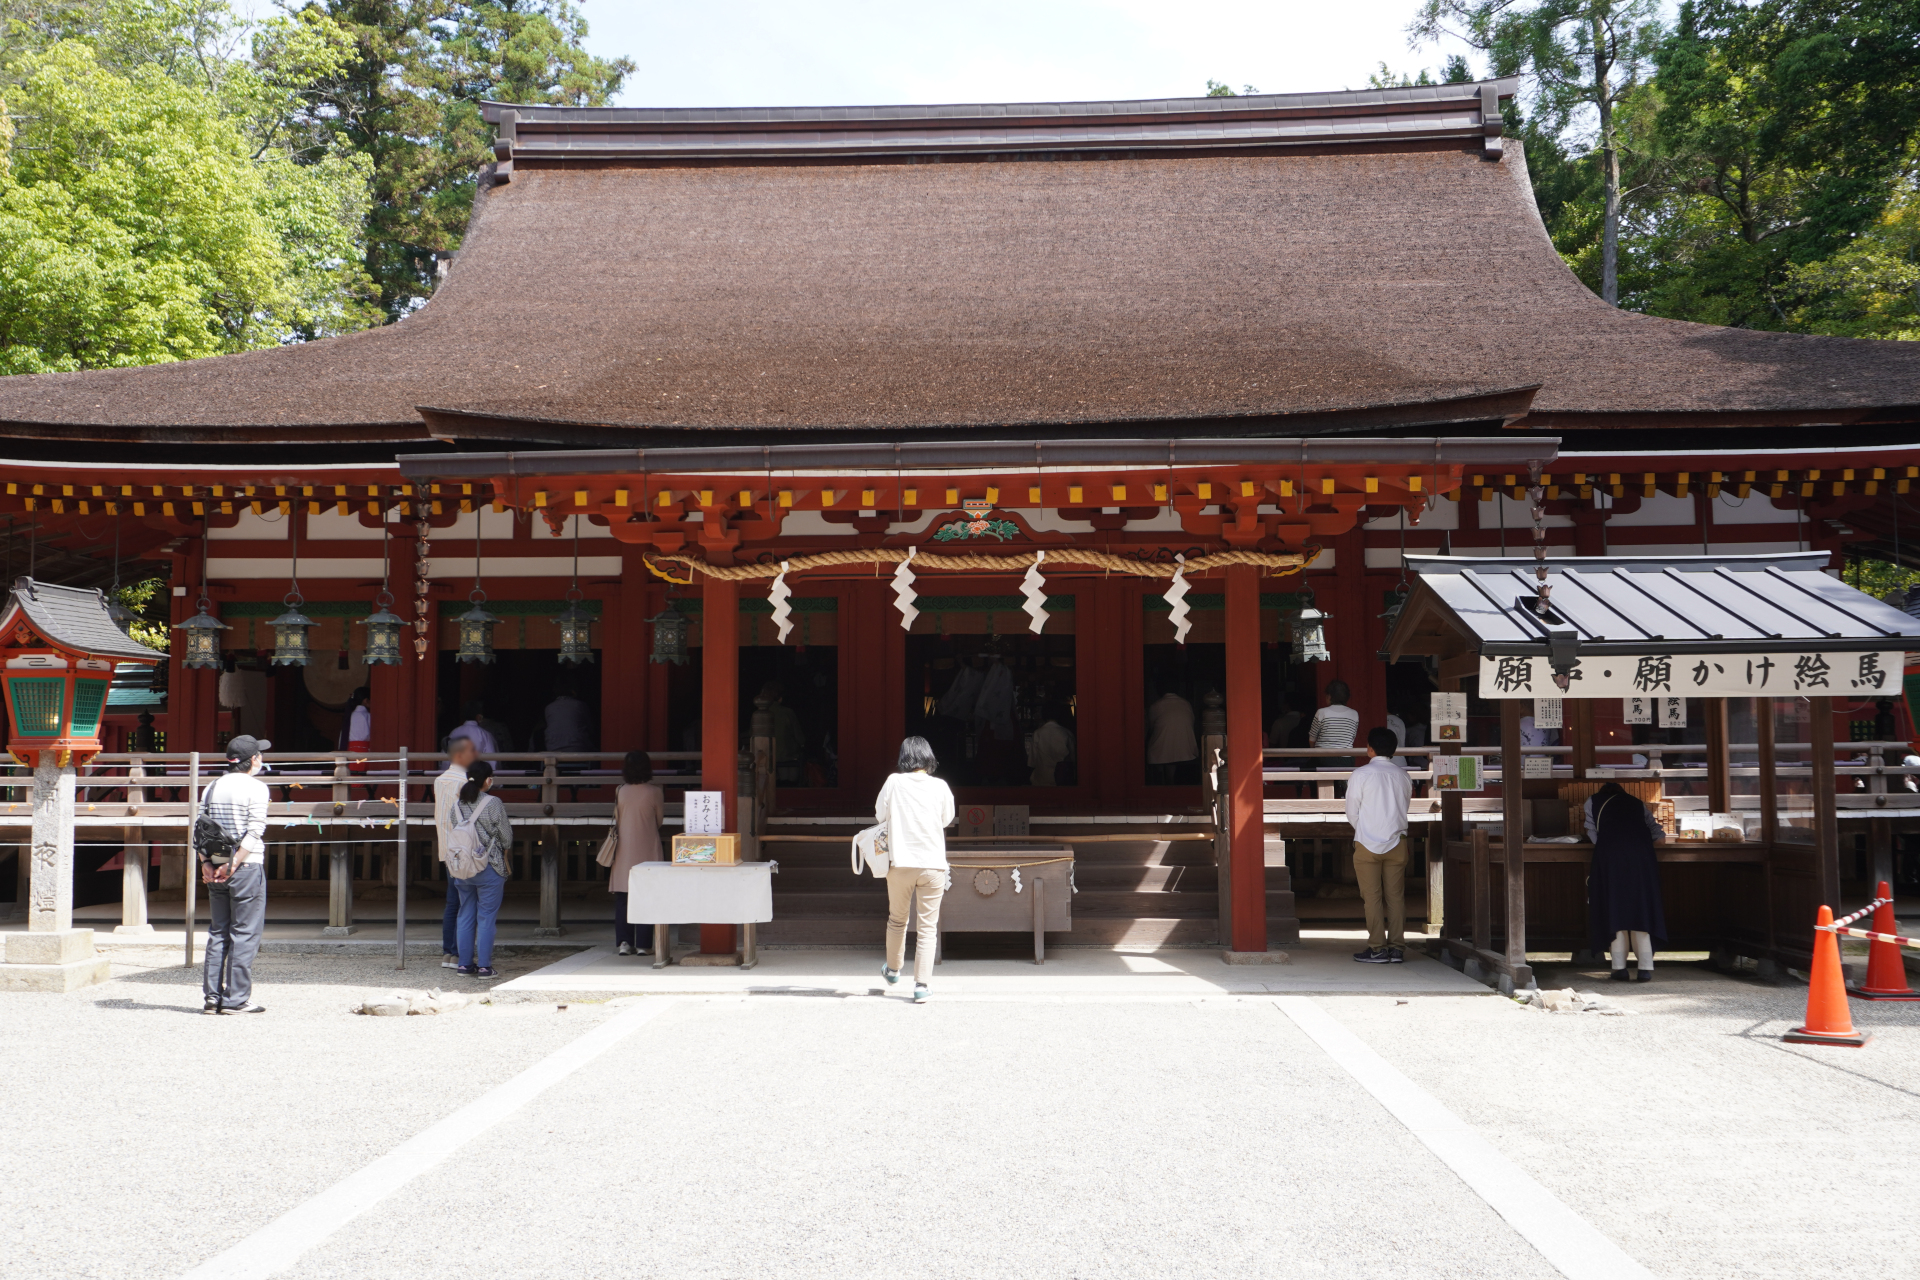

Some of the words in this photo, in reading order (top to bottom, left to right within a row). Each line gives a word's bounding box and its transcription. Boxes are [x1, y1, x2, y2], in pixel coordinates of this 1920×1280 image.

[1667, 697, 1681, 720] 絵馬
[702, 795, 711, 833] おみくじ
